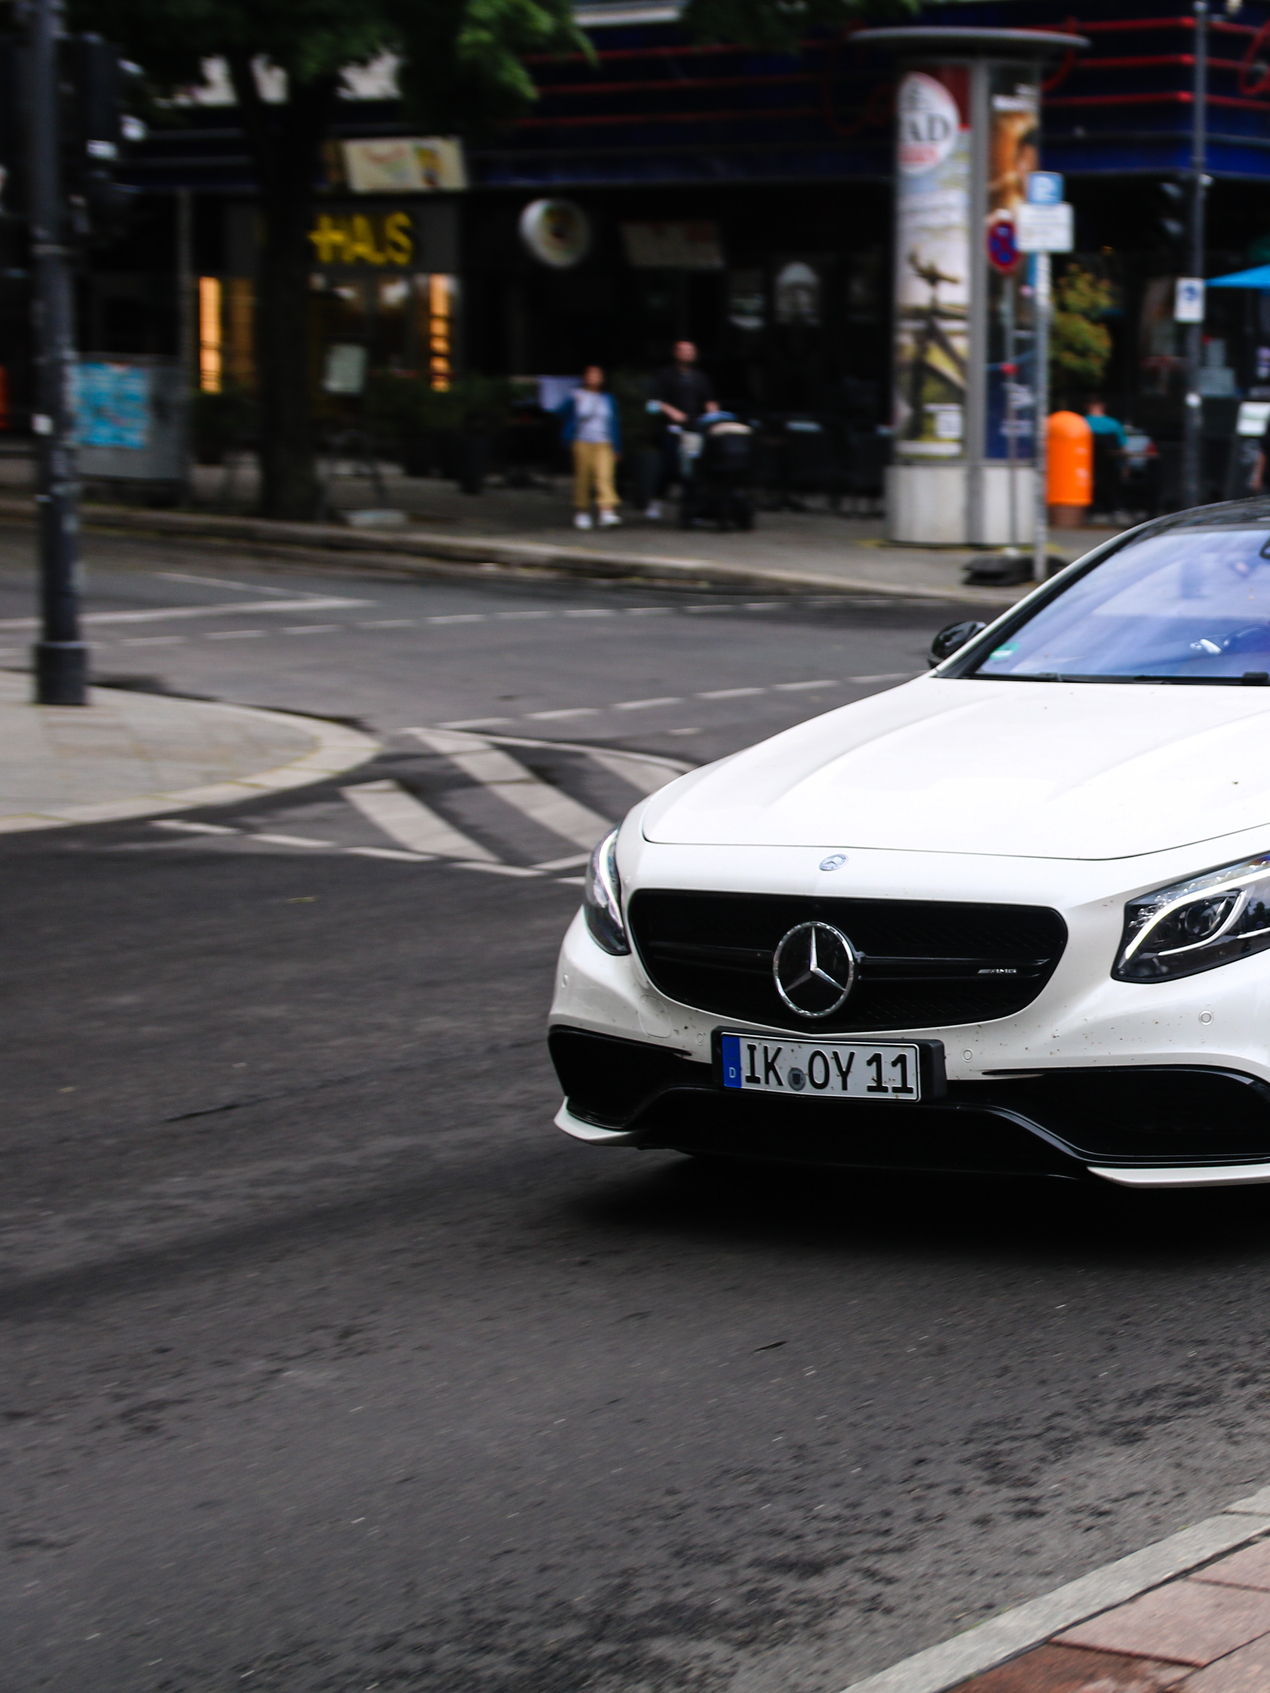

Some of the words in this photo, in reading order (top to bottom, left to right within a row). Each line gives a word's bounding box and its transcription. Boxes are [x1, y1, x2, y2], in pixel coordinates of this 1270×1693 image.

[729, 1067, 736, 1079] D
[745, 1043, 784, 1087] IK
[808, 1050, 856, 1091] OY
[866, 1052, 914, 1094] 11
